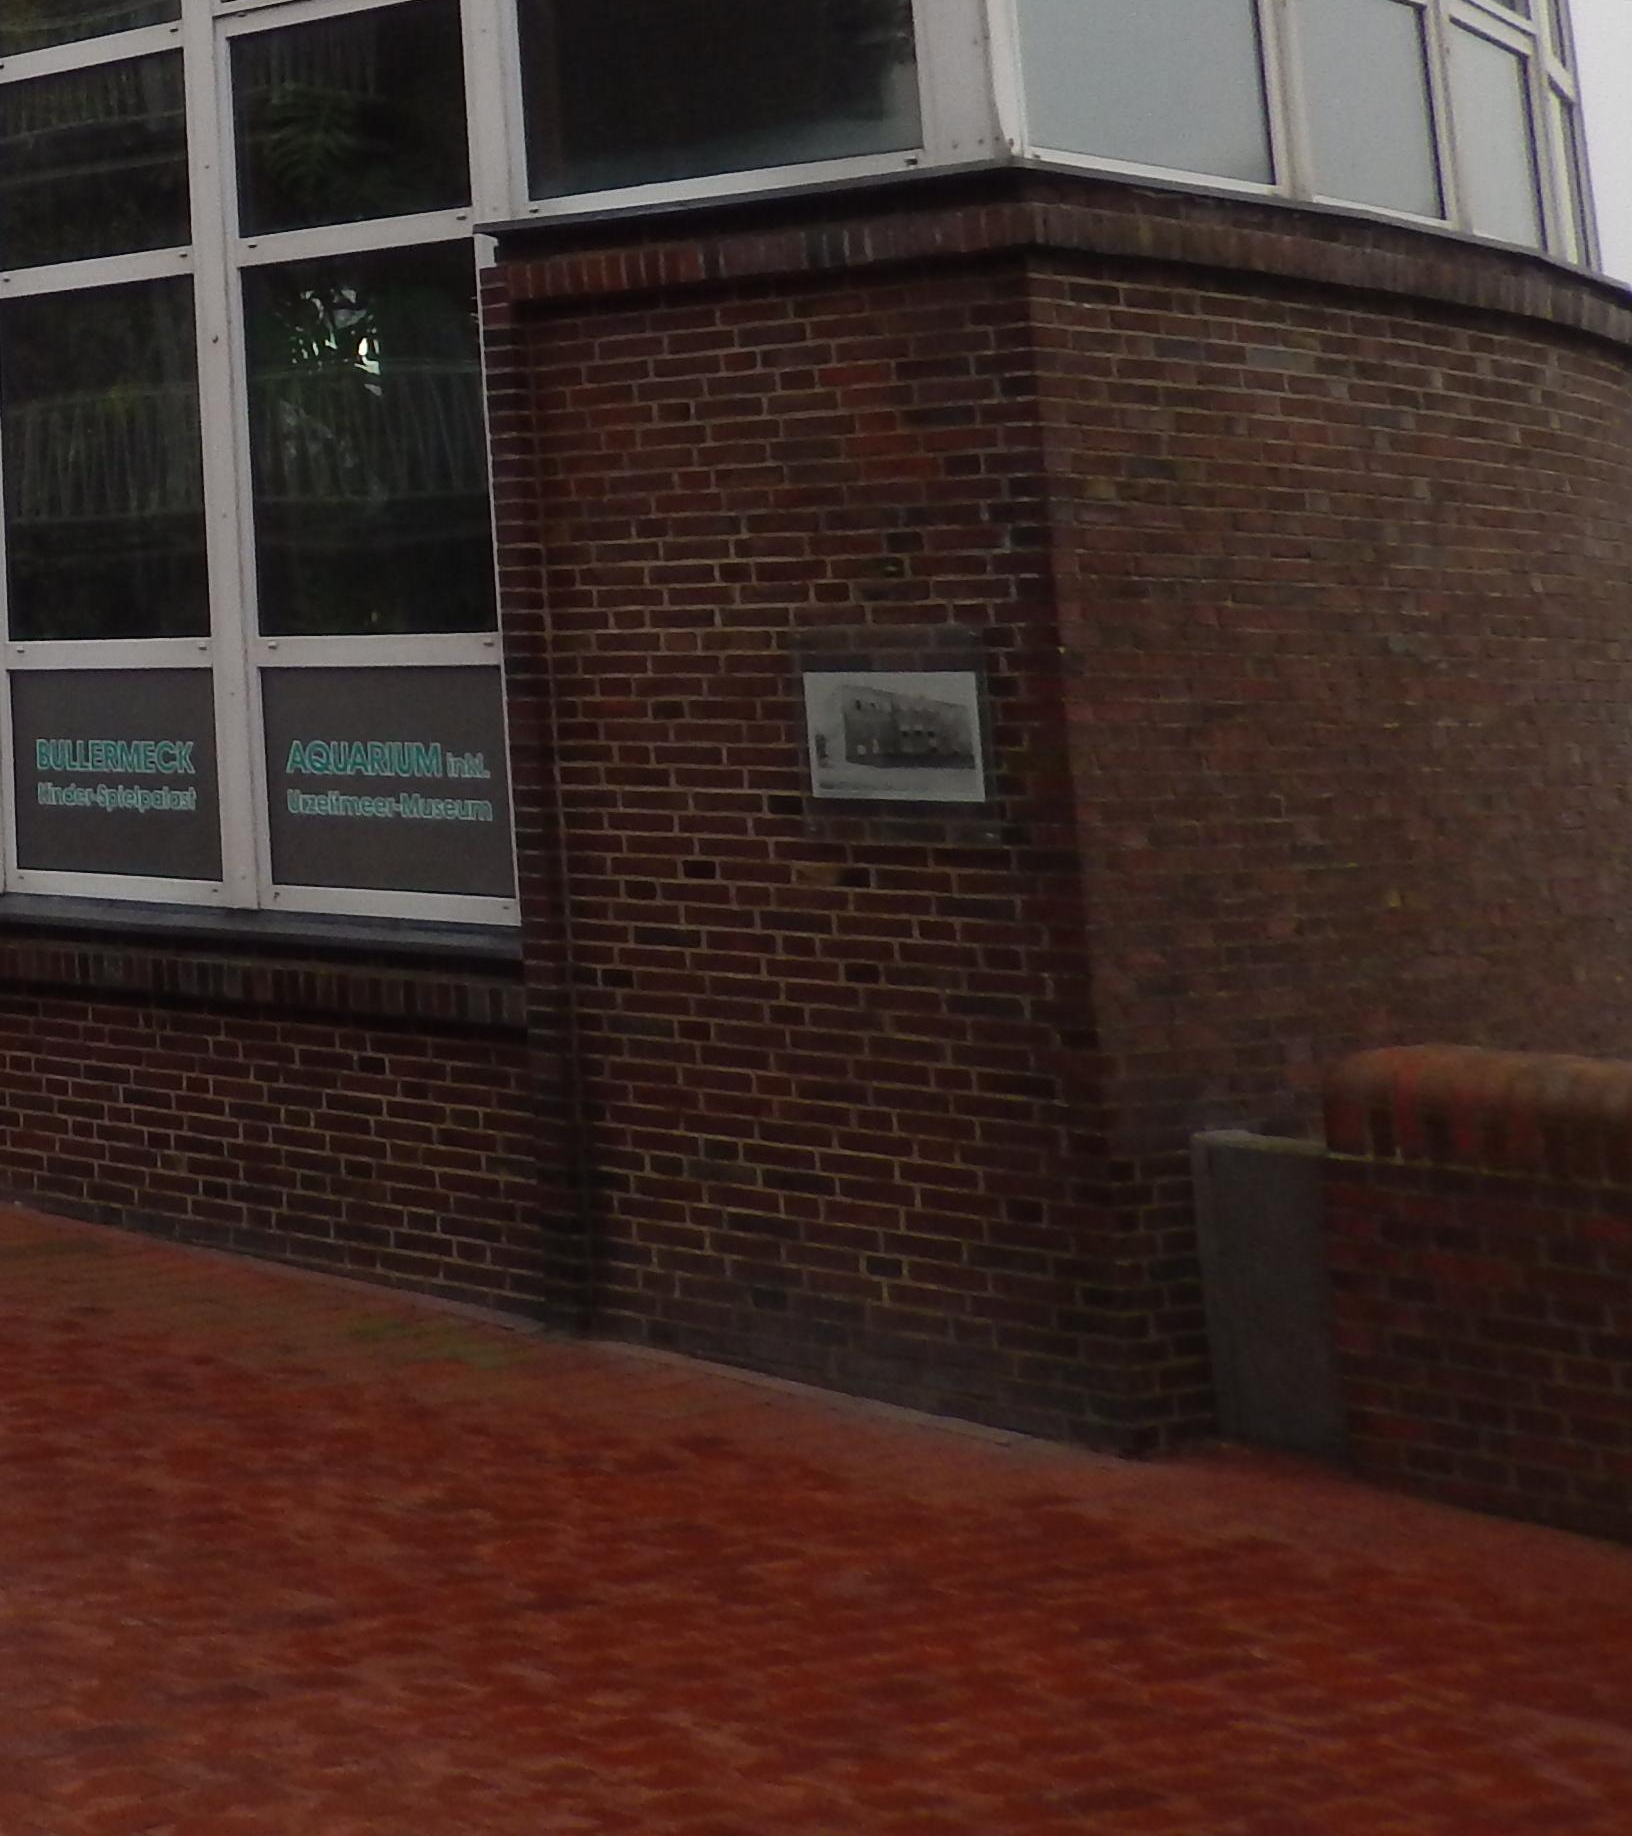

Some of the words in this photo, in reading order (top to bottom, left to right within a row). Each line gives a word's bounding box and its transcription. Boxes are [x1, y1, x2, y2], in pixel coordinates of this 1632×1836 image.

[35, 738, 196, 774] BULLERMECK
[285, 739, 443, 779] AQUARIUM
[445, 751, 492, 779] inkl.
